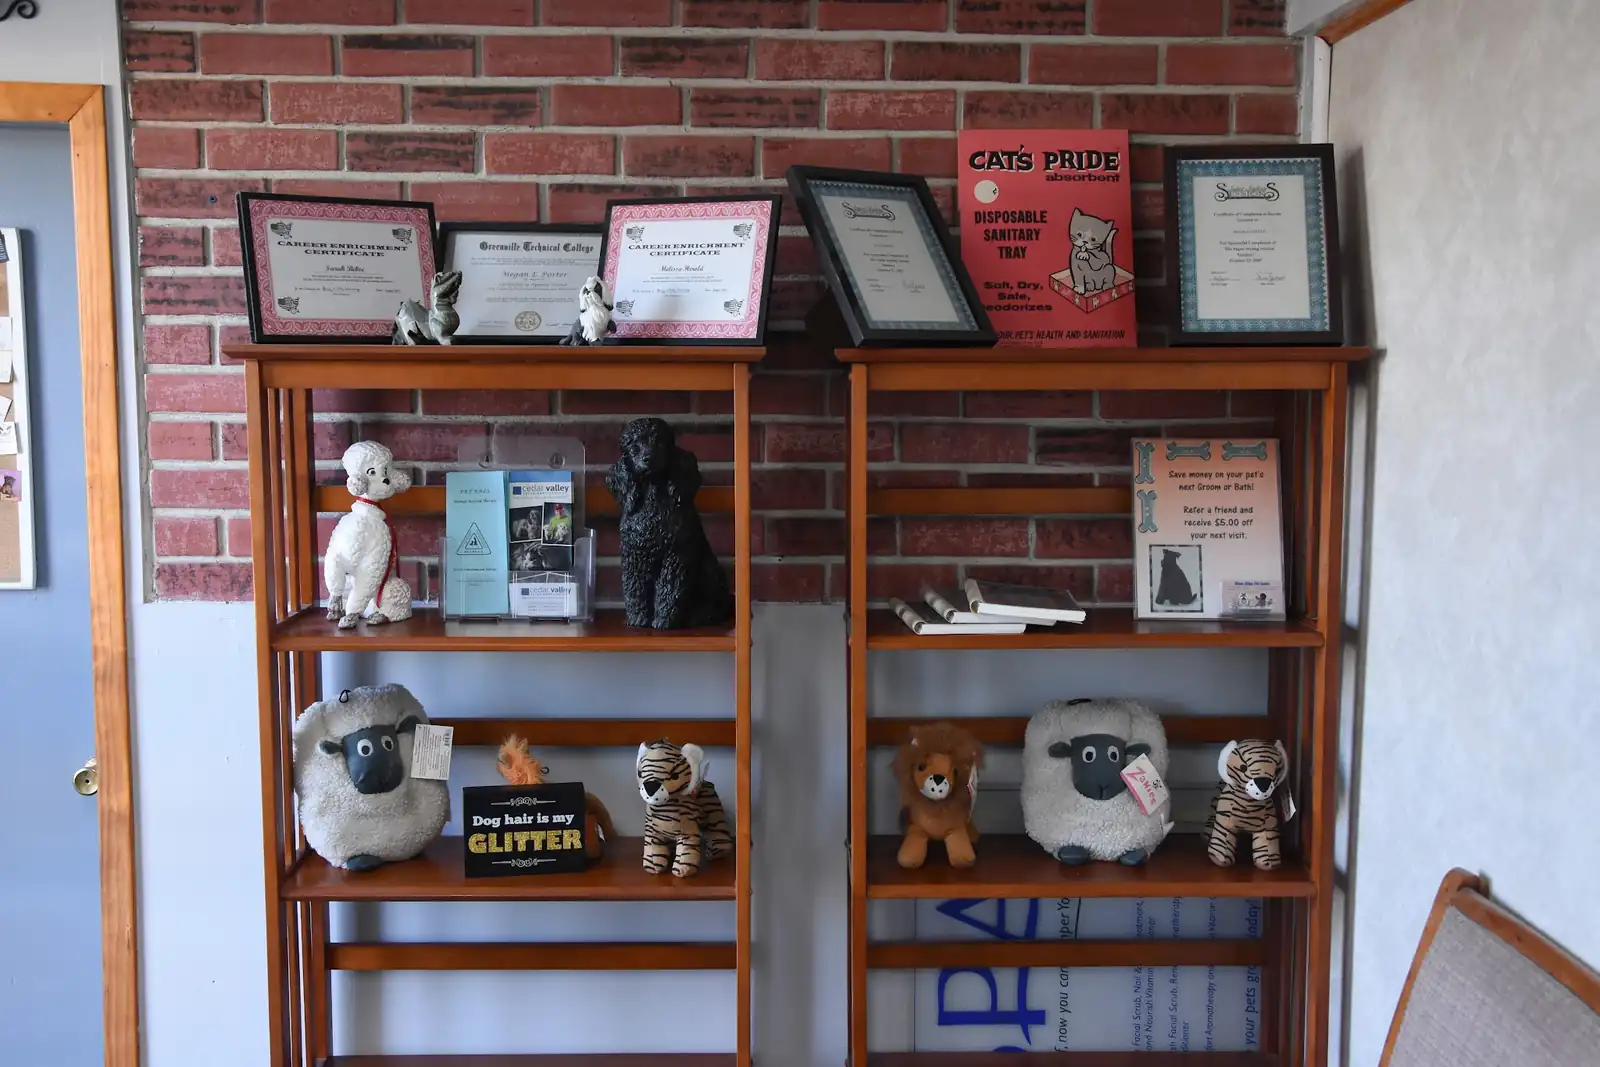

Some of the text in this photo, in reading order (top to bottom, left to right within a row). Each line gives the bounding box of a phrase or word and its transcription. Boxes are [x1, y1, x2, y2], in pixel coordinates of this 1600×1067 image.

[968, 144, 1121, 173] CAT'S PRIDE
[1045, 173, 1120, 182] absorbent
[974, 209, 1048, 225] DISPOSABLE
[983, 228, 1041, 242] SANITARY
[277, 240, 408, 252] CAREER ENRICHMENT
[479, 241, 594, 254] Greenville Technical College
[672, 242, 745, 250] ENRICHMENT
[304, 249, 385, 257] CERTIFICATE
[998, 246, 1028, 260] TRAY
[1017, 281, 1045, 291] Dry,
[982, 303, 1053, 312] eodorizes
[1036, 330, 1064, 340] HEALTH
[1065, 330, 1082, 340] AND
[1082, 330, 1125, 340] SANITATION
[1168, 470, 1264, 480] Save money on your pet's
[545, 484, 569, 494] valley
[1197, 483, 1222, 491] Groom
[1234, 483, 1255, 491] Bath!
[1183, 506, 1204, 514] Refer
[1214, 506, 1238, 514] friend
[1239, 506, 1254, 514] and
[1184, 518, 1254, 527] receive $5.00 off
[1190, 531, 1248, 541] your next visit.
[472, 812, 575, 828] Dog hair is my
[467, 829, 583, 854] GLITTER
[1132, 976, 1142, 993] Nail
[1059, 992, 1072, 1014] you
[1244, 987, 1260, 1014] pets
[1132, 995, 1142, 1021] Scrub,
[1058, 1018, 1068, 1043] now
[1168, 1014, 1178, 1039] Facial
[1245, 1017, 1257, 1045] your
[1132, 1023, 1141, 1047] Facial
